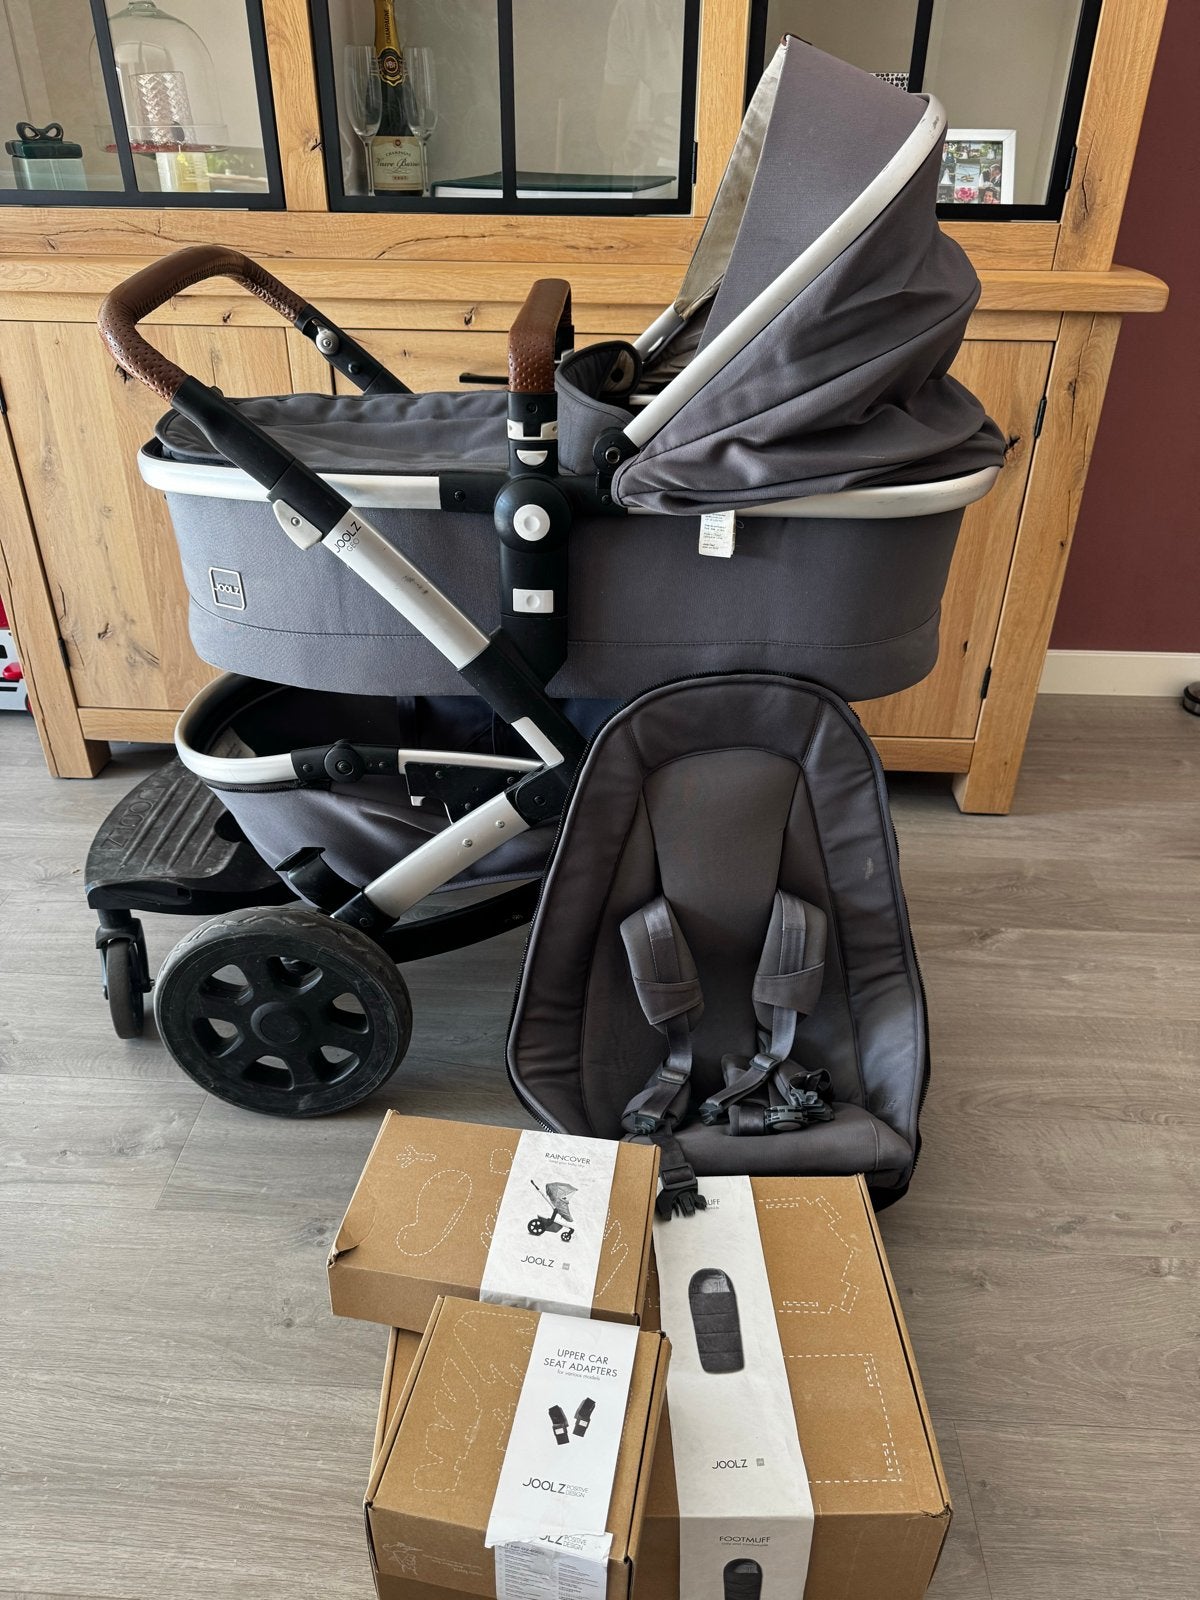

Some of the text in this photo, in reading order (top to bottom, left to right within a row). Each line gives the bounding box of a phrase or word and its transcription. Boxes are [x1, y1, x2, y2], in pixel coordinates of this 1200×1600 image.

[333, 520, 361, 553] JOOLZ
[346, 537, 360, 552] GEO
[213, 582, 241, 595] JOOLZ
[545, 1152, 591, 1165] RAINCOVER
[520, 1255, 555, 1268] JOOLZ
[557, 1348, 609, 1365] UPPER CAR
[543, 1357, 618, 1378] SEAT ADAPTERS
[711, 1458, 748, 1470] JOOLZ
[522, 1477, 589, 1495] JOOLZ POSITIVE
[565, 1490, 586, 1498] DESIGN
[562, 1540, 584, 1551] DESIGN
[719, 1535, 771, 1544] FOOTMUFF
